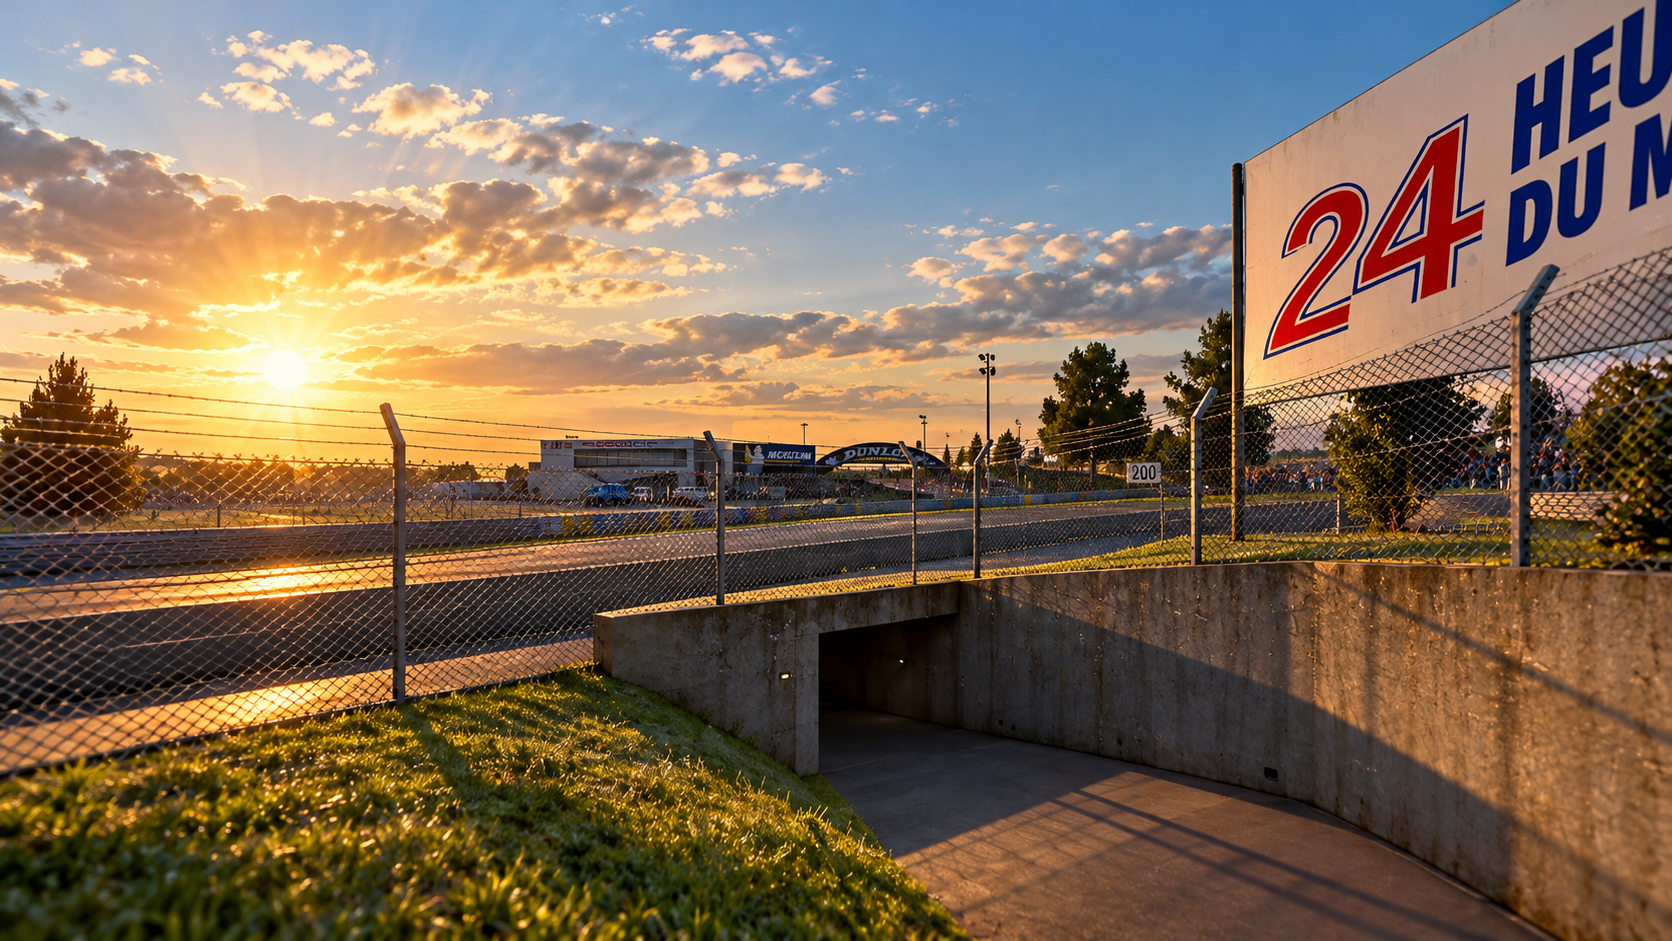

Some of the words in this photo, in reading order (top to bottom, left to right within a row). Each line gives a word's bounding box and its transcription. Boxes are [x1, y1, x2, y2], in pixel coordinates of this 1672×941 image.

[1511, 0, 1672, 175] HEU
[1263, 113, 1486, 361] 24
[1505, 141, 1606, 267] DU
[843, 446, 913, 462] DUNLO
[1131, 464, 1156, 480] 200
